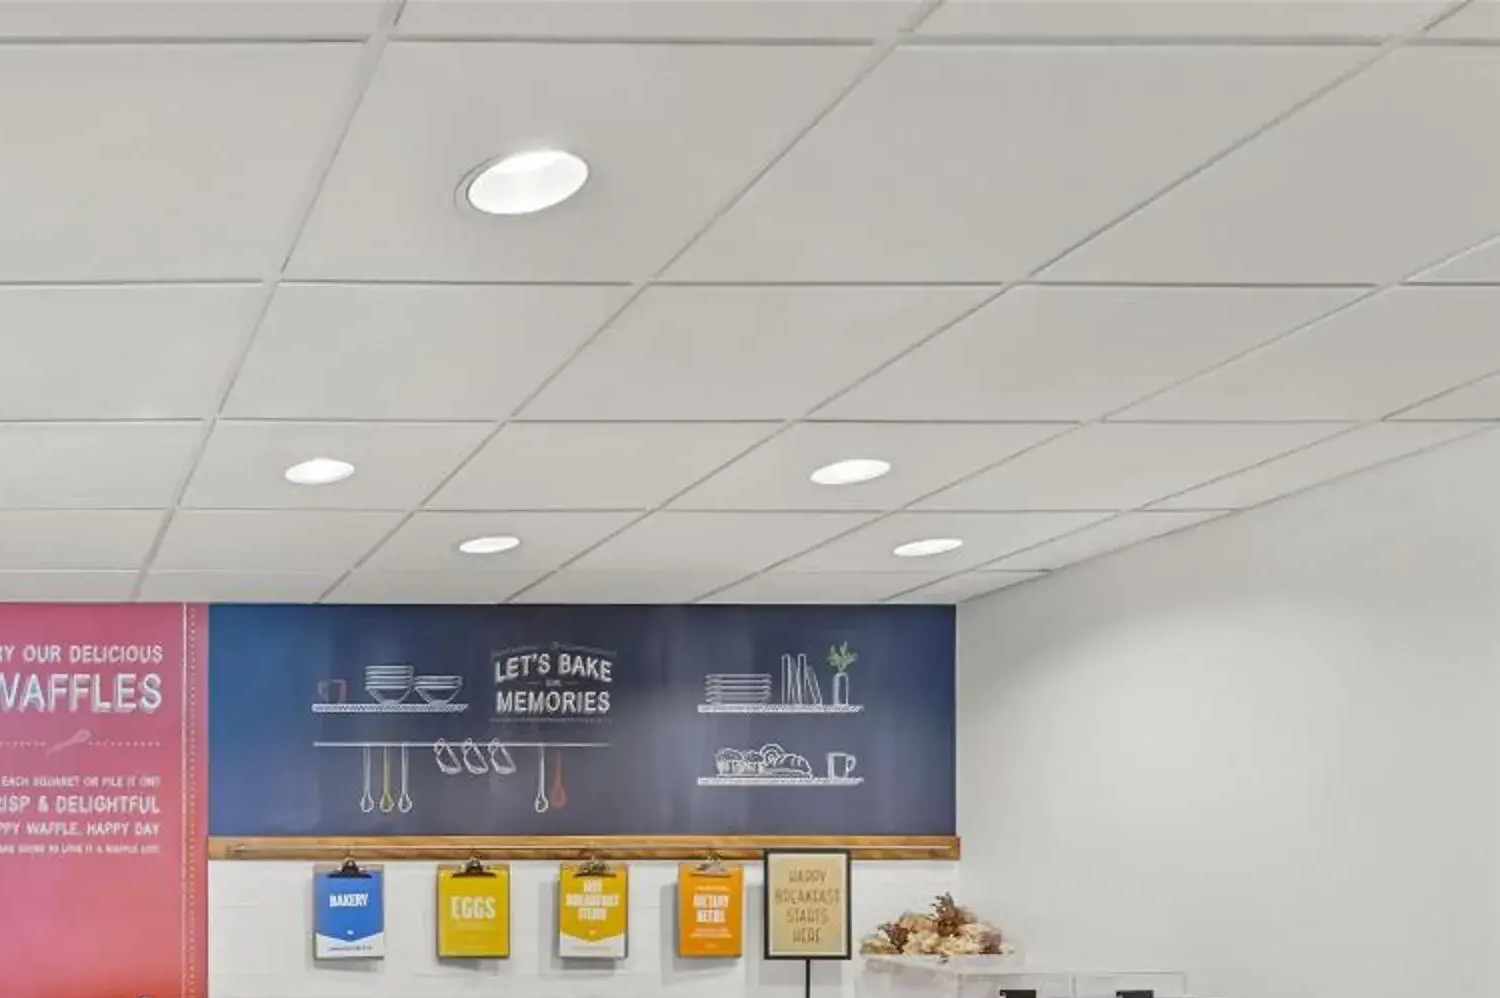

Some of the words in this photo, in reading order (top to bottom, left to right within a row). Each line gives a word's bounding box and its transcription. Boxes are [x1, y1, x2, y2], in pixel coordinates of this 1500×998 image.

[22, 644, 61, 663] OUR
[69, 644, 163, 664] DELICIOUS
[495, 653, 550, 683] LET'S
[558, 653, 612, 683] BAKE
[496, 691, 611, 714] MEMORIES
[1, 775, 29, 788] EACH
[38, 795, 49, 813] &
[55, 795, 161, 814] DELIGHTFUL
[86, 821, 128, 836] HAPPY
[135, 821, 160, 836] DAY
[329, 893, 368, 907] BAKERY
[451, 896, 496, 919] EGGS
